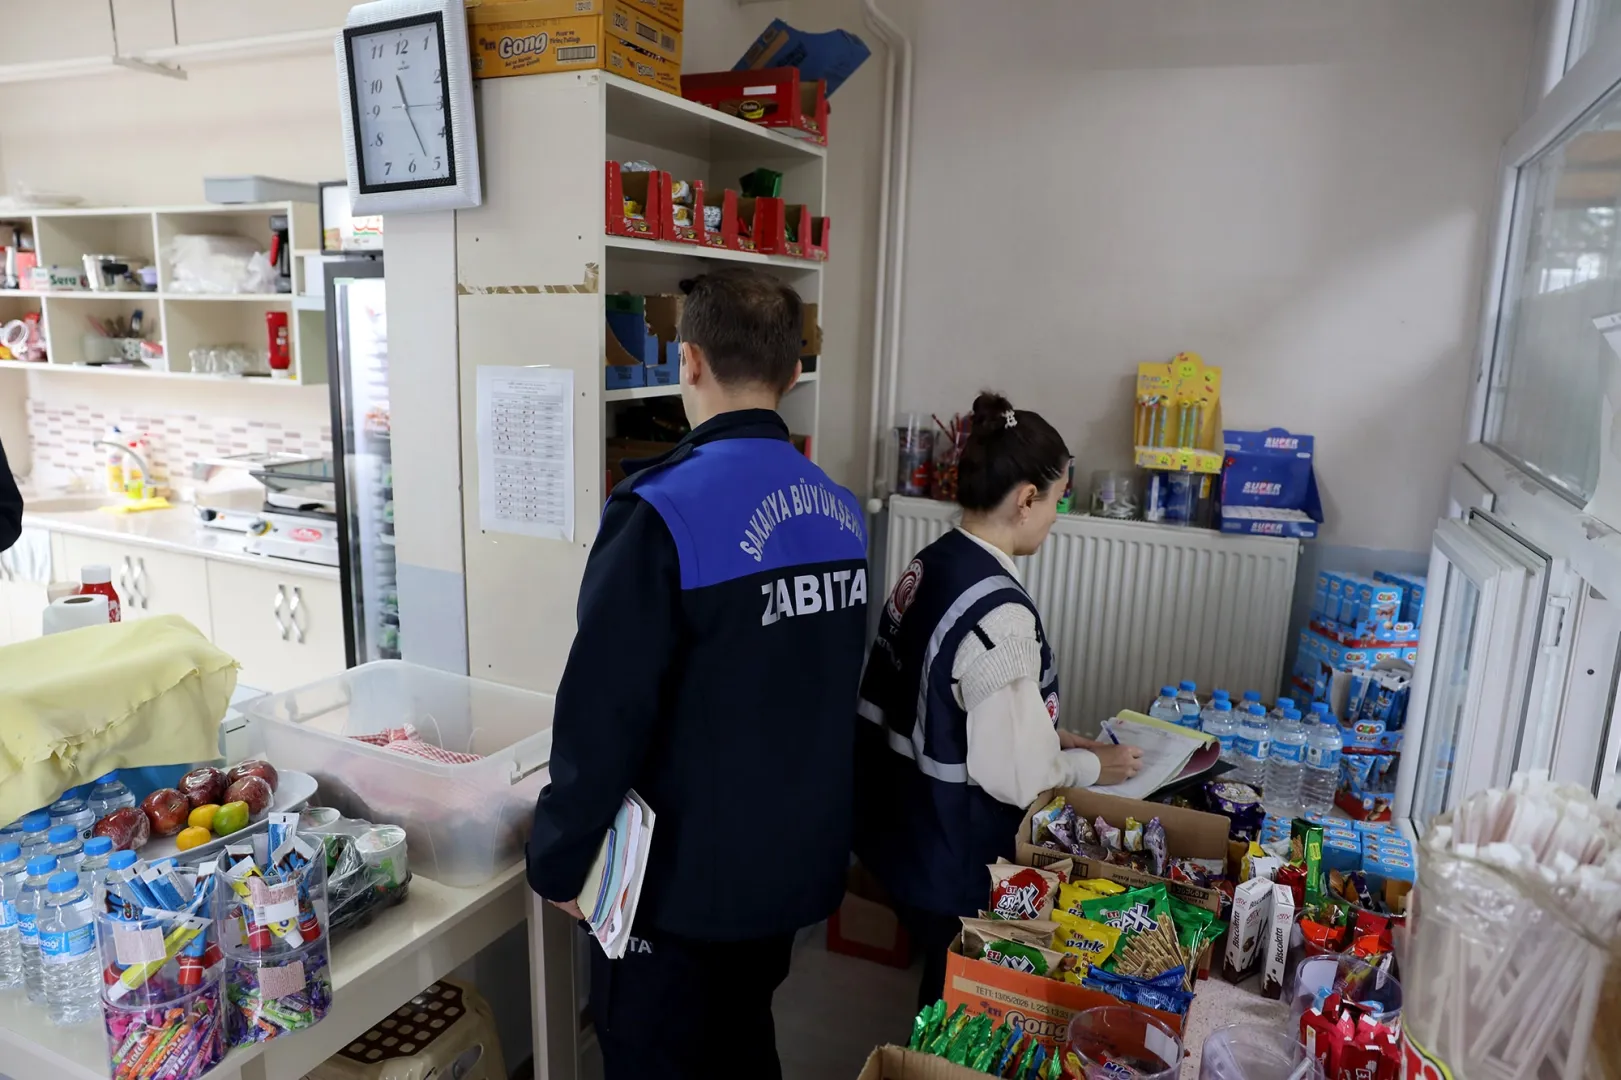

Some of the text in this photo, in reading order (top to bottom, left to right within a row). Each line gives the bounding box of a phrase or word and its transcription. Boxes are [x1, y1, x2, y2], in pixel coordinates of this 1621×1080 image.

[394, 39, 409, 55] 12
[423, 35, 430, 51] 1
[499, 32, 548, 59] Gong
[370, 44, 384, 60] 11
[433, 69, 442, 84] 2
[370, 79, 383, 94] 10
[372, 104, 381, 120] 9
[375, 132, 384, 147] 8
[384, 162, 392, 176] 7
[408, 158, 417, 173] 6
[432, 156, 441, 171] 5
[739, 489, 792, 563] SAKARYA
[761, 568, 868, 626] ZABITA
[1232, 911, 1240, 949] Biscolata
[1274, 927, 1284, 965] Biscolata
[1004, 1010, 1070, 1042] Gong
